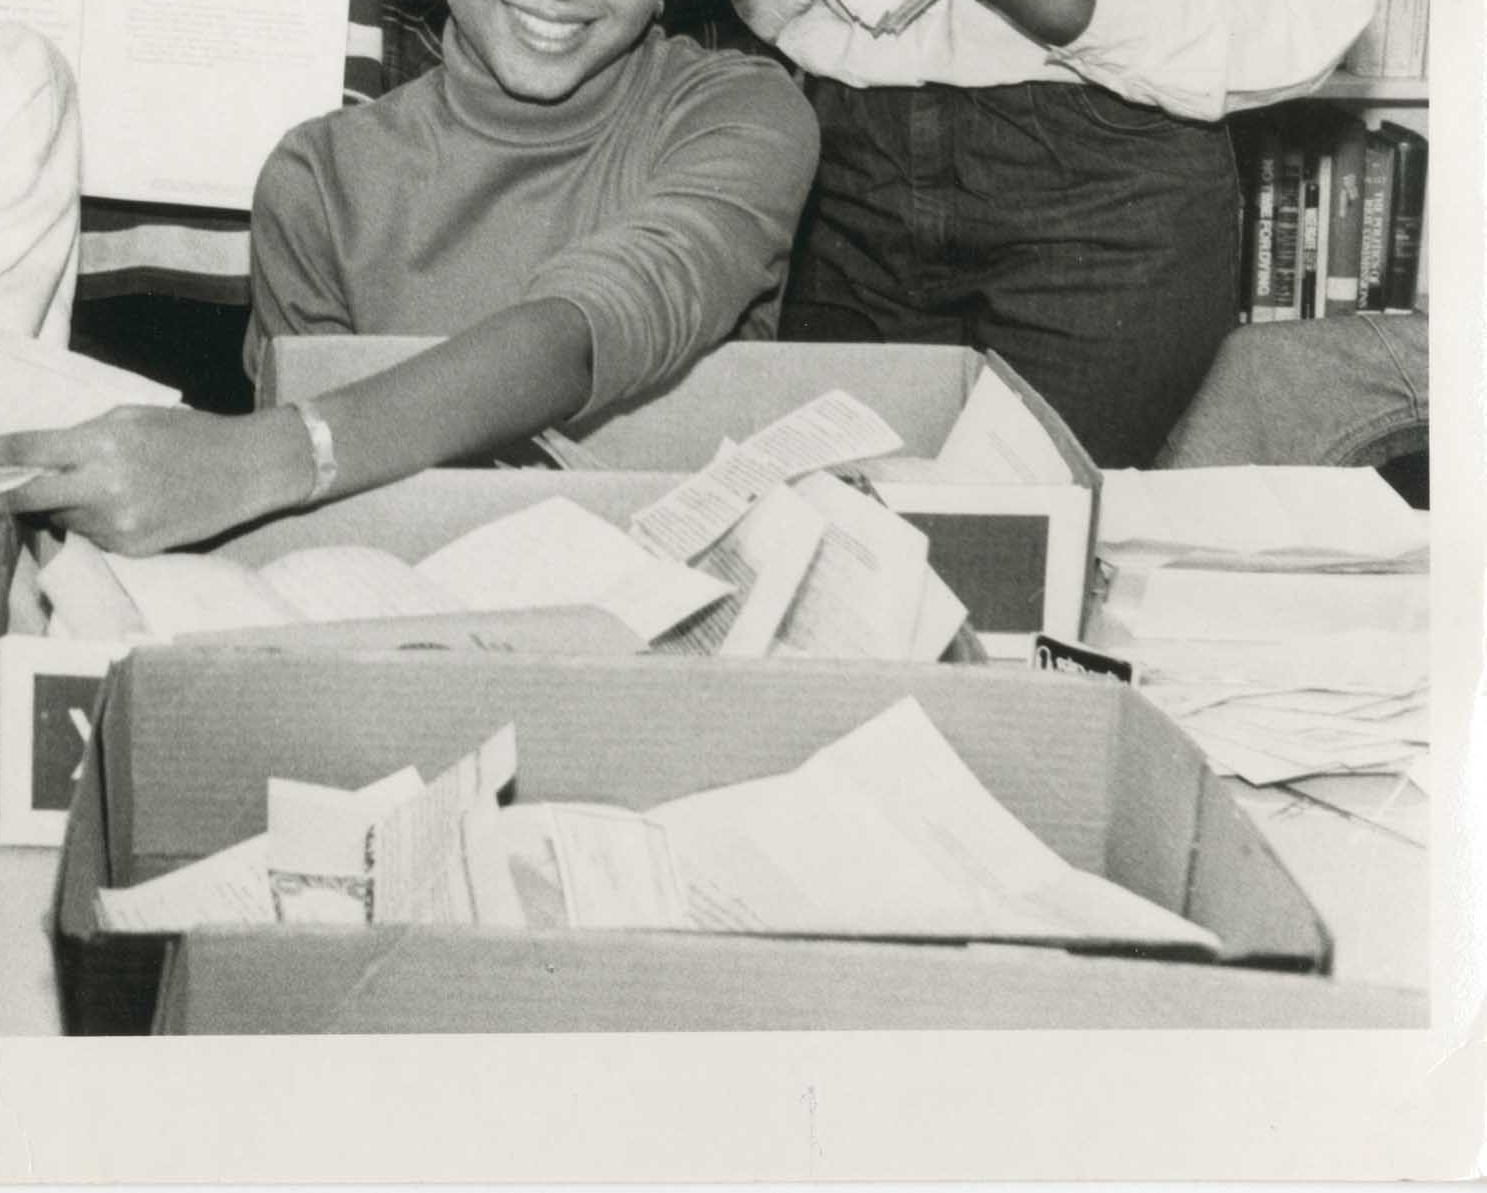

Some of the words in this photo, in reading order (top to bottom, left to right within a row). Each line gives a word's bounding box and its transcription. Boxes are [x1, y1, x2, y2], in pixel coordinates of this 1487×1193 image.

[1261, 159, 1274, 182] NO
[1259, 184, 1274, 219] TIME
[1373, 192, 1385, 214] THE
[1258, 220, 1273, 250] FOR
[1371, 216, 1384, 268] POLITICS
[1257, 251, 1272, 296] DYING
